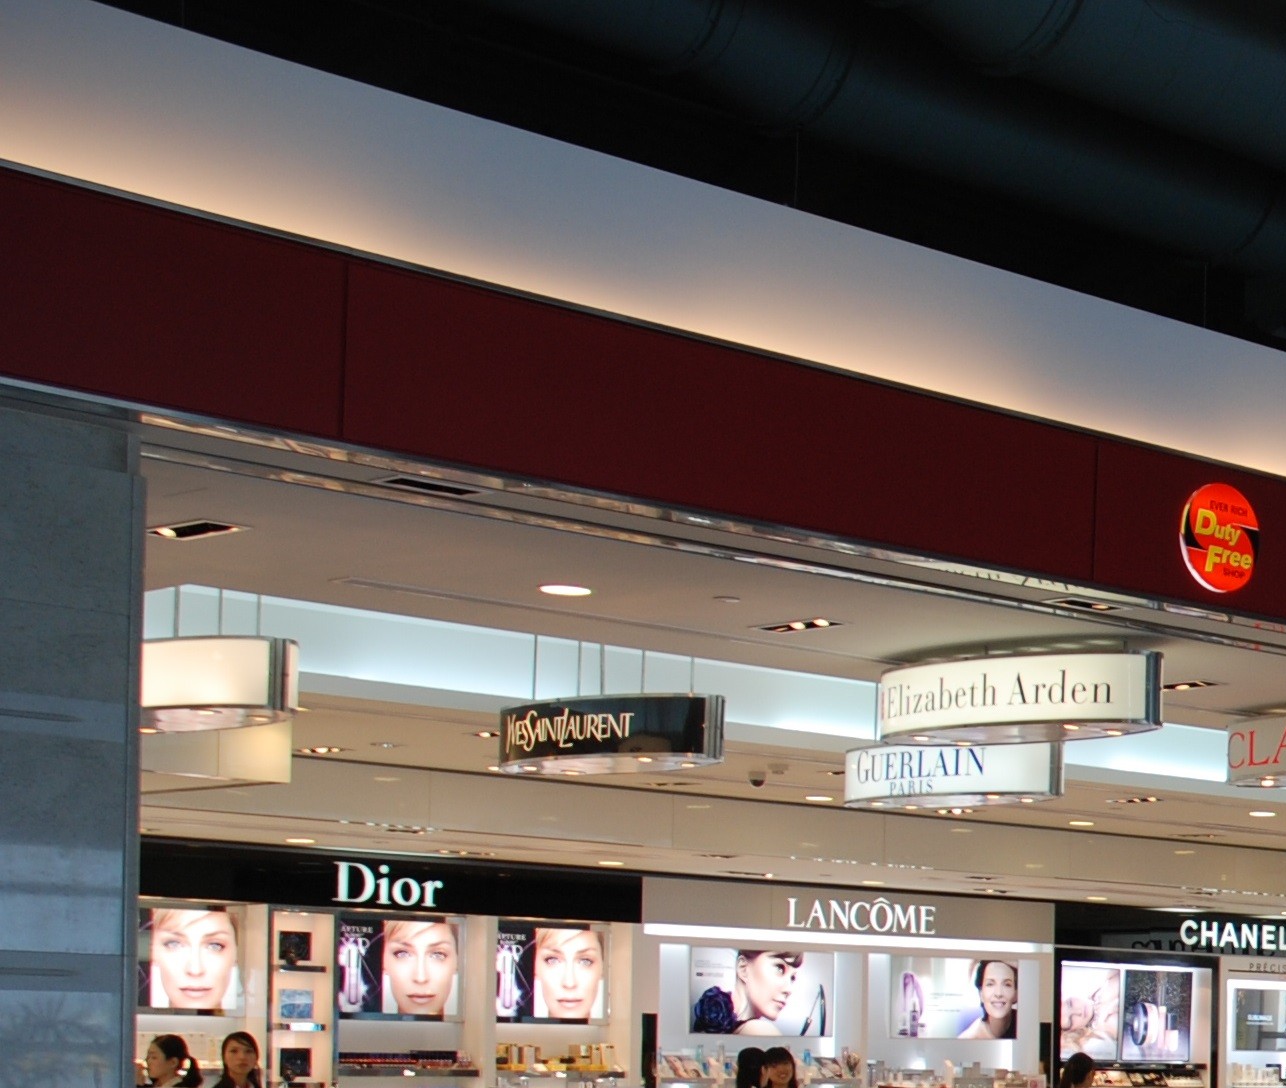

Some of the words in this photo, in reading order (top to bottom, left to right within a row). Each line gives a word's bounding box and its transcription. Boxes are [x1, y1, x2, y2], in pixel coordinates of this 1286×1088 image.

[1195, 507, 1241, 547] Duty
[1205, 544, 1253, 572] Free
[886, 672, 996, 721] Elizabeth
[1007, 669, 1113, 704] Arden
[857, 746, 986, 784] GUERLAIN
[889, 779, 935, 796] PARIS
[331, 861, 444, 907] Dior
[787, 897, 936, 935] LANCÔME
